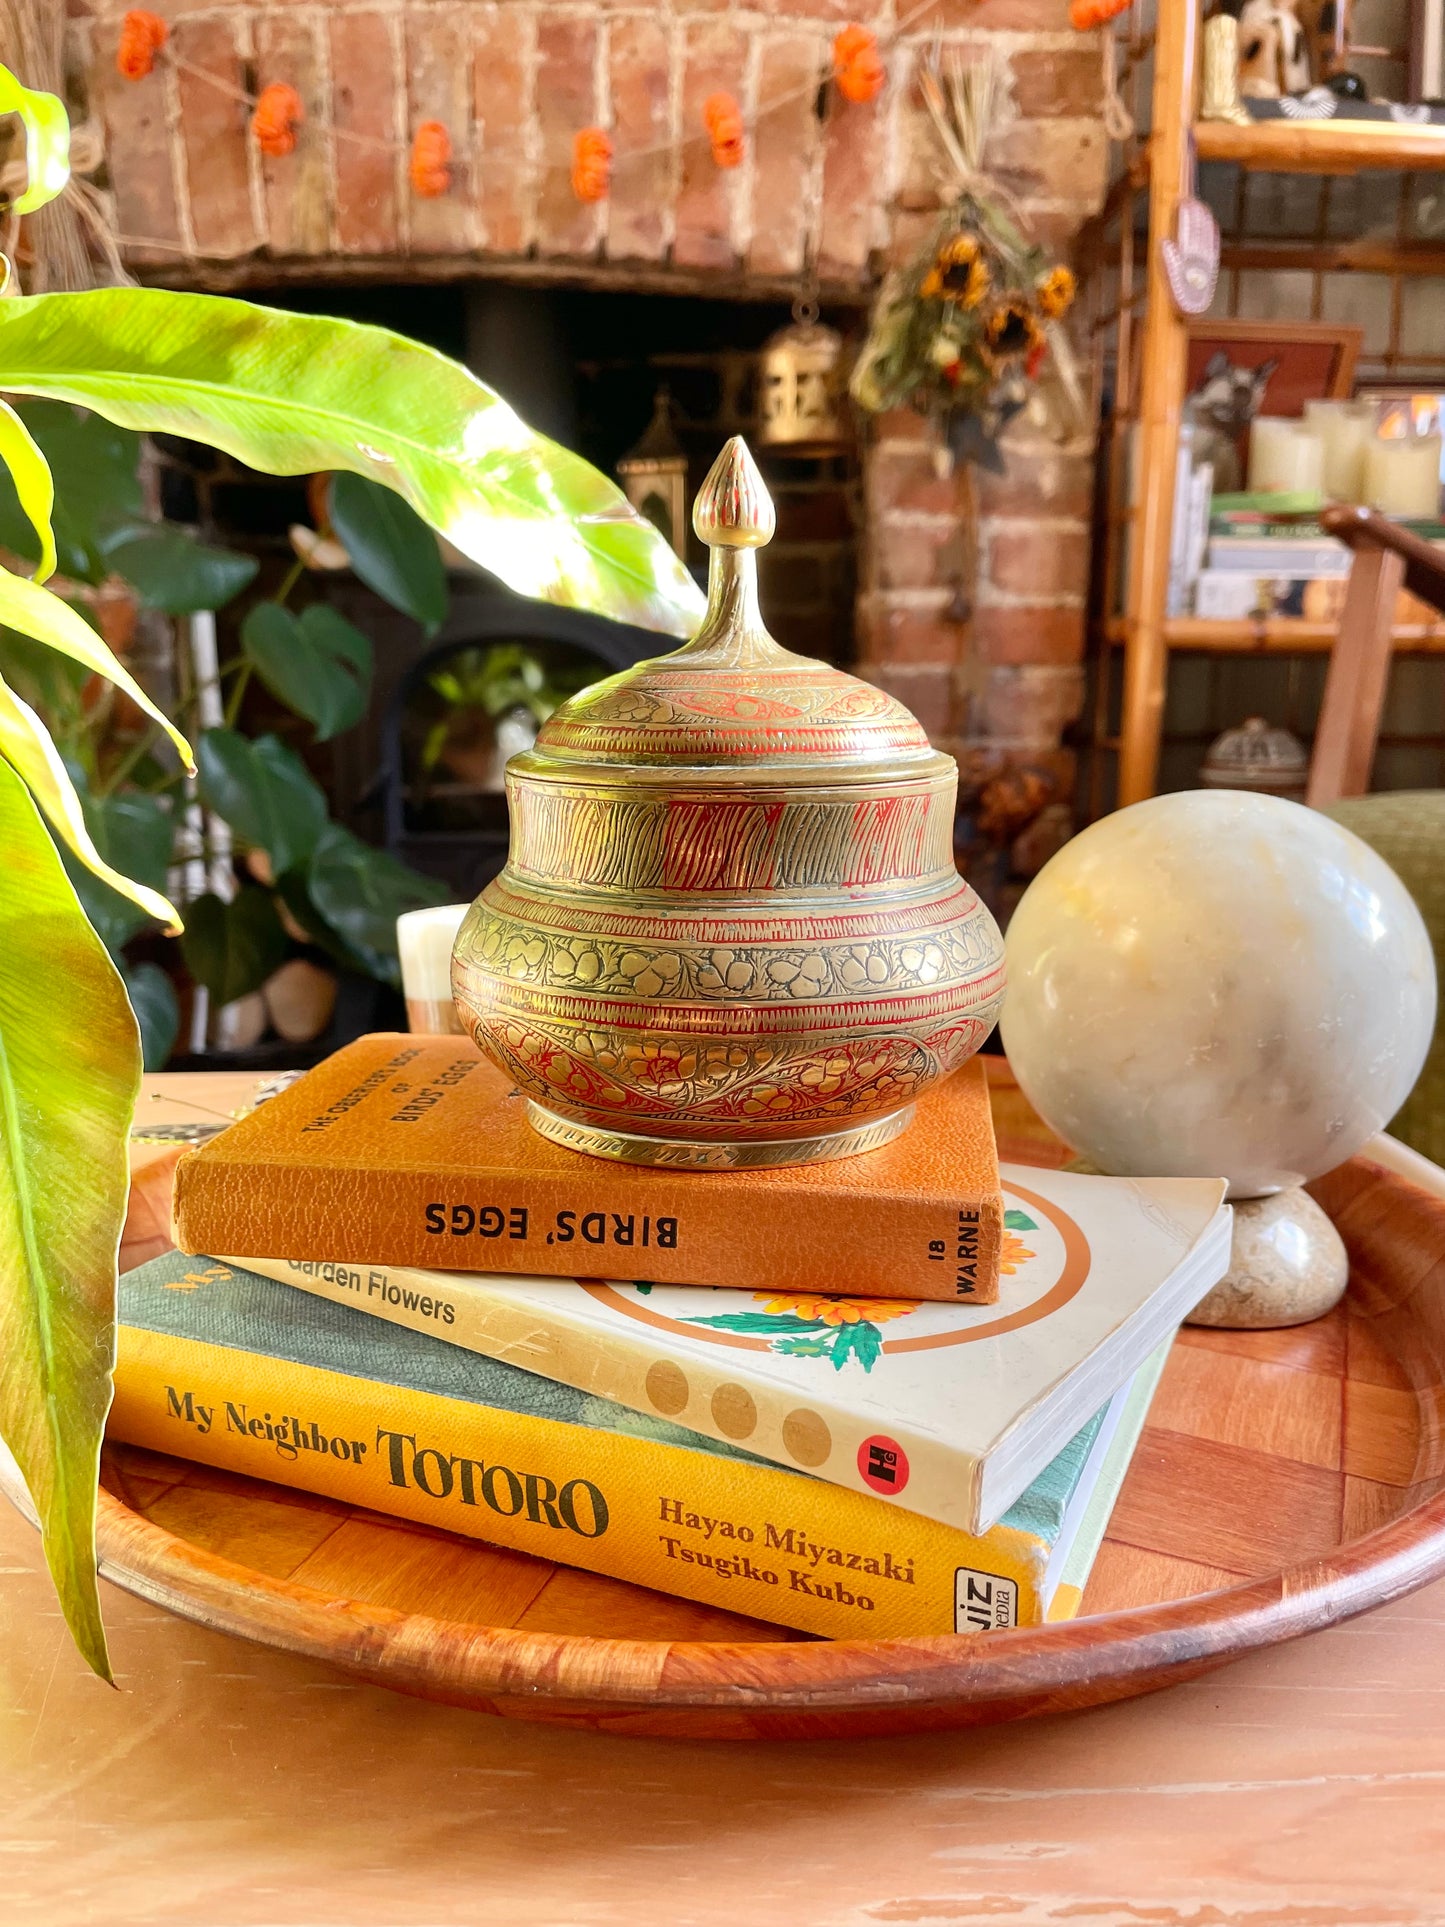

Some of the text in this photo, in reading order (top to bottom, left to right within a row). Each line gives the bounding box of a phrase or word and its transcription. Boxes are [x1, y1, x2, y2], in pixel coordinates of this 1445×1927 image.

[433, 1060, 480, 1086] EGGS
[301, 1115, 340, 1132] THE
[425, 1203, 528, 1240] EGGS
[928, 1240, 946, 1260] 18
[957, 1210, 980, 1295] WARNE
[368, 1271, 455, 1325] Flowers
[164, 1385, 215, 1434] My
[223, 1401, 367, 1465] Neighbor
[658, 1496, 916, 1585] Hayao Miyazaki
[659, 1535, 876, 1611] Tsugiko Kubo
